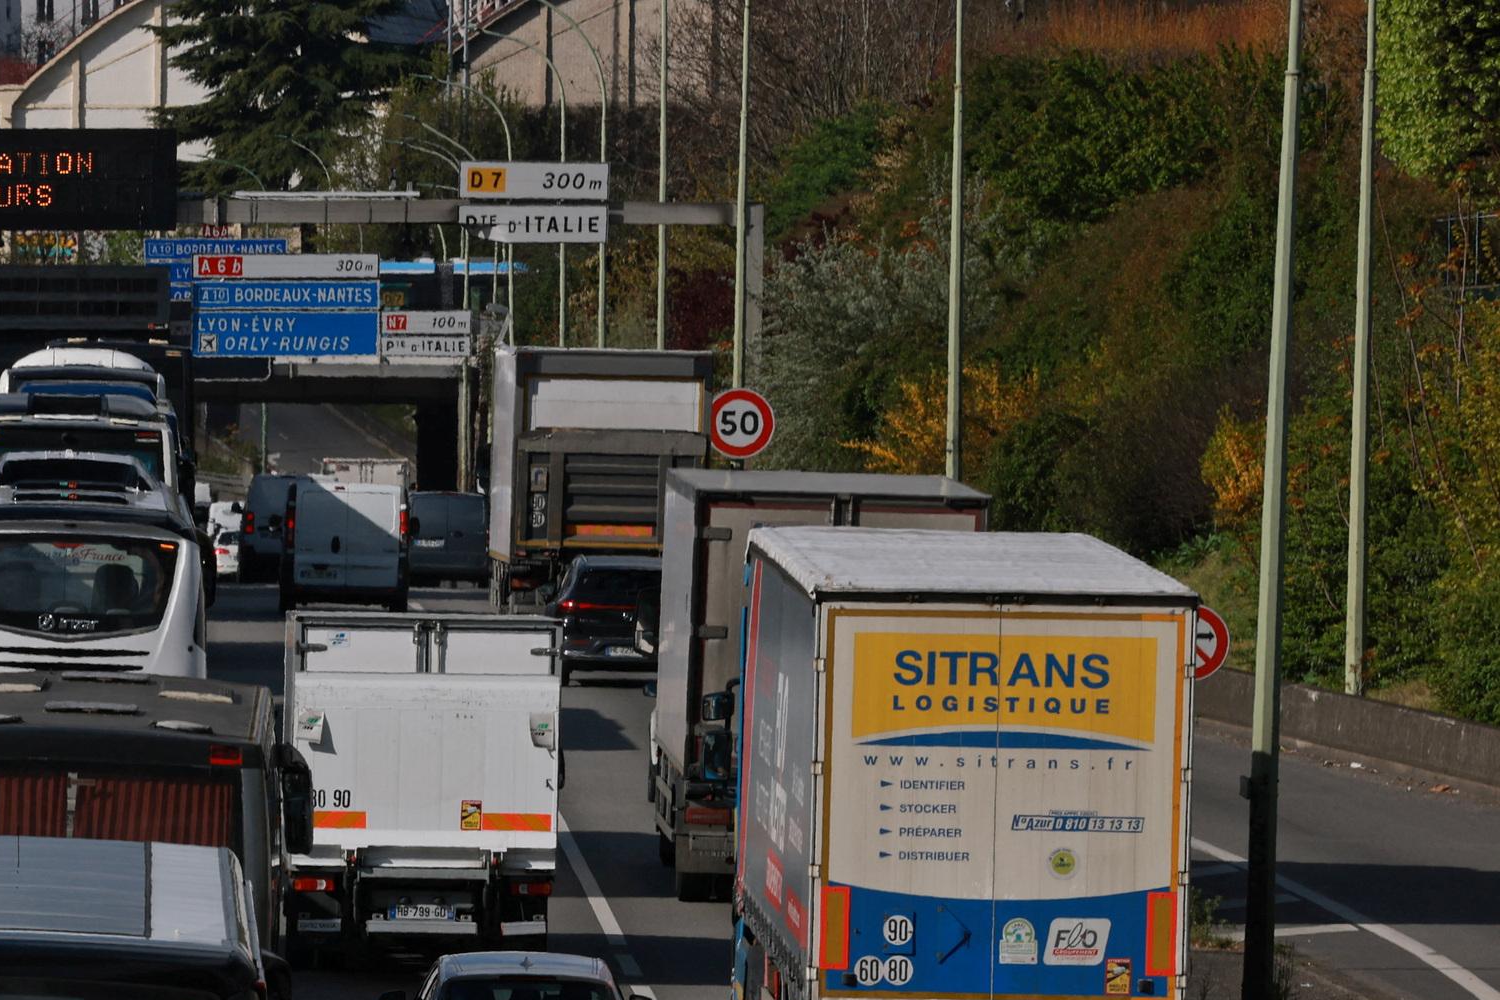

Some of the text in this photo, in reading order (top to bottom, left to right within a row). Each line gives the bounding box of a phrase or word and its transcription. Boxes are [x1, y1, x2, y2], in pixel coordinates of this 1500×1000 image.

[542, 172, 585, 189] 300
[589, 181, 602, 189] m
[508, 216, 599, 233] D'ITALIE
[176, 244, 283, 255] BORDEAUX-NANTES
[336, 260, 363, 272] 300
[235, 288, 372, 303] BORDEAUX-NANTES
[198, 314, 296, 332] LYON-ÉVRY
[388, 316, 406, 328] N7
[432, 317, 455, 328] 100
[225, 336, 350, 351] ORLY-RUNGIS
[720, 410, 759, 436] 50
[894, 649, 1110, 689] SITRANS
[893, 694, 1110, 715] LOGISTIQUE
[900, 779, 965, 791] IDENTIFIER
[333, 789, 351, 809] 90
[900, 803, 957, 815] STOCKER
[899, 825, 963, 838] PRÉPARER
[1065, 818, 1088, 830] 810
[1092, 819, 1105, 830] 13
[1109, 820, 1123, 830] 13
[1127, 820, 1141, 831] 13
[899, 850, 970, 863] DISTRIBUER
[888, 918, 909, 943] 90
[860, 959, 909, 983] 60 80
